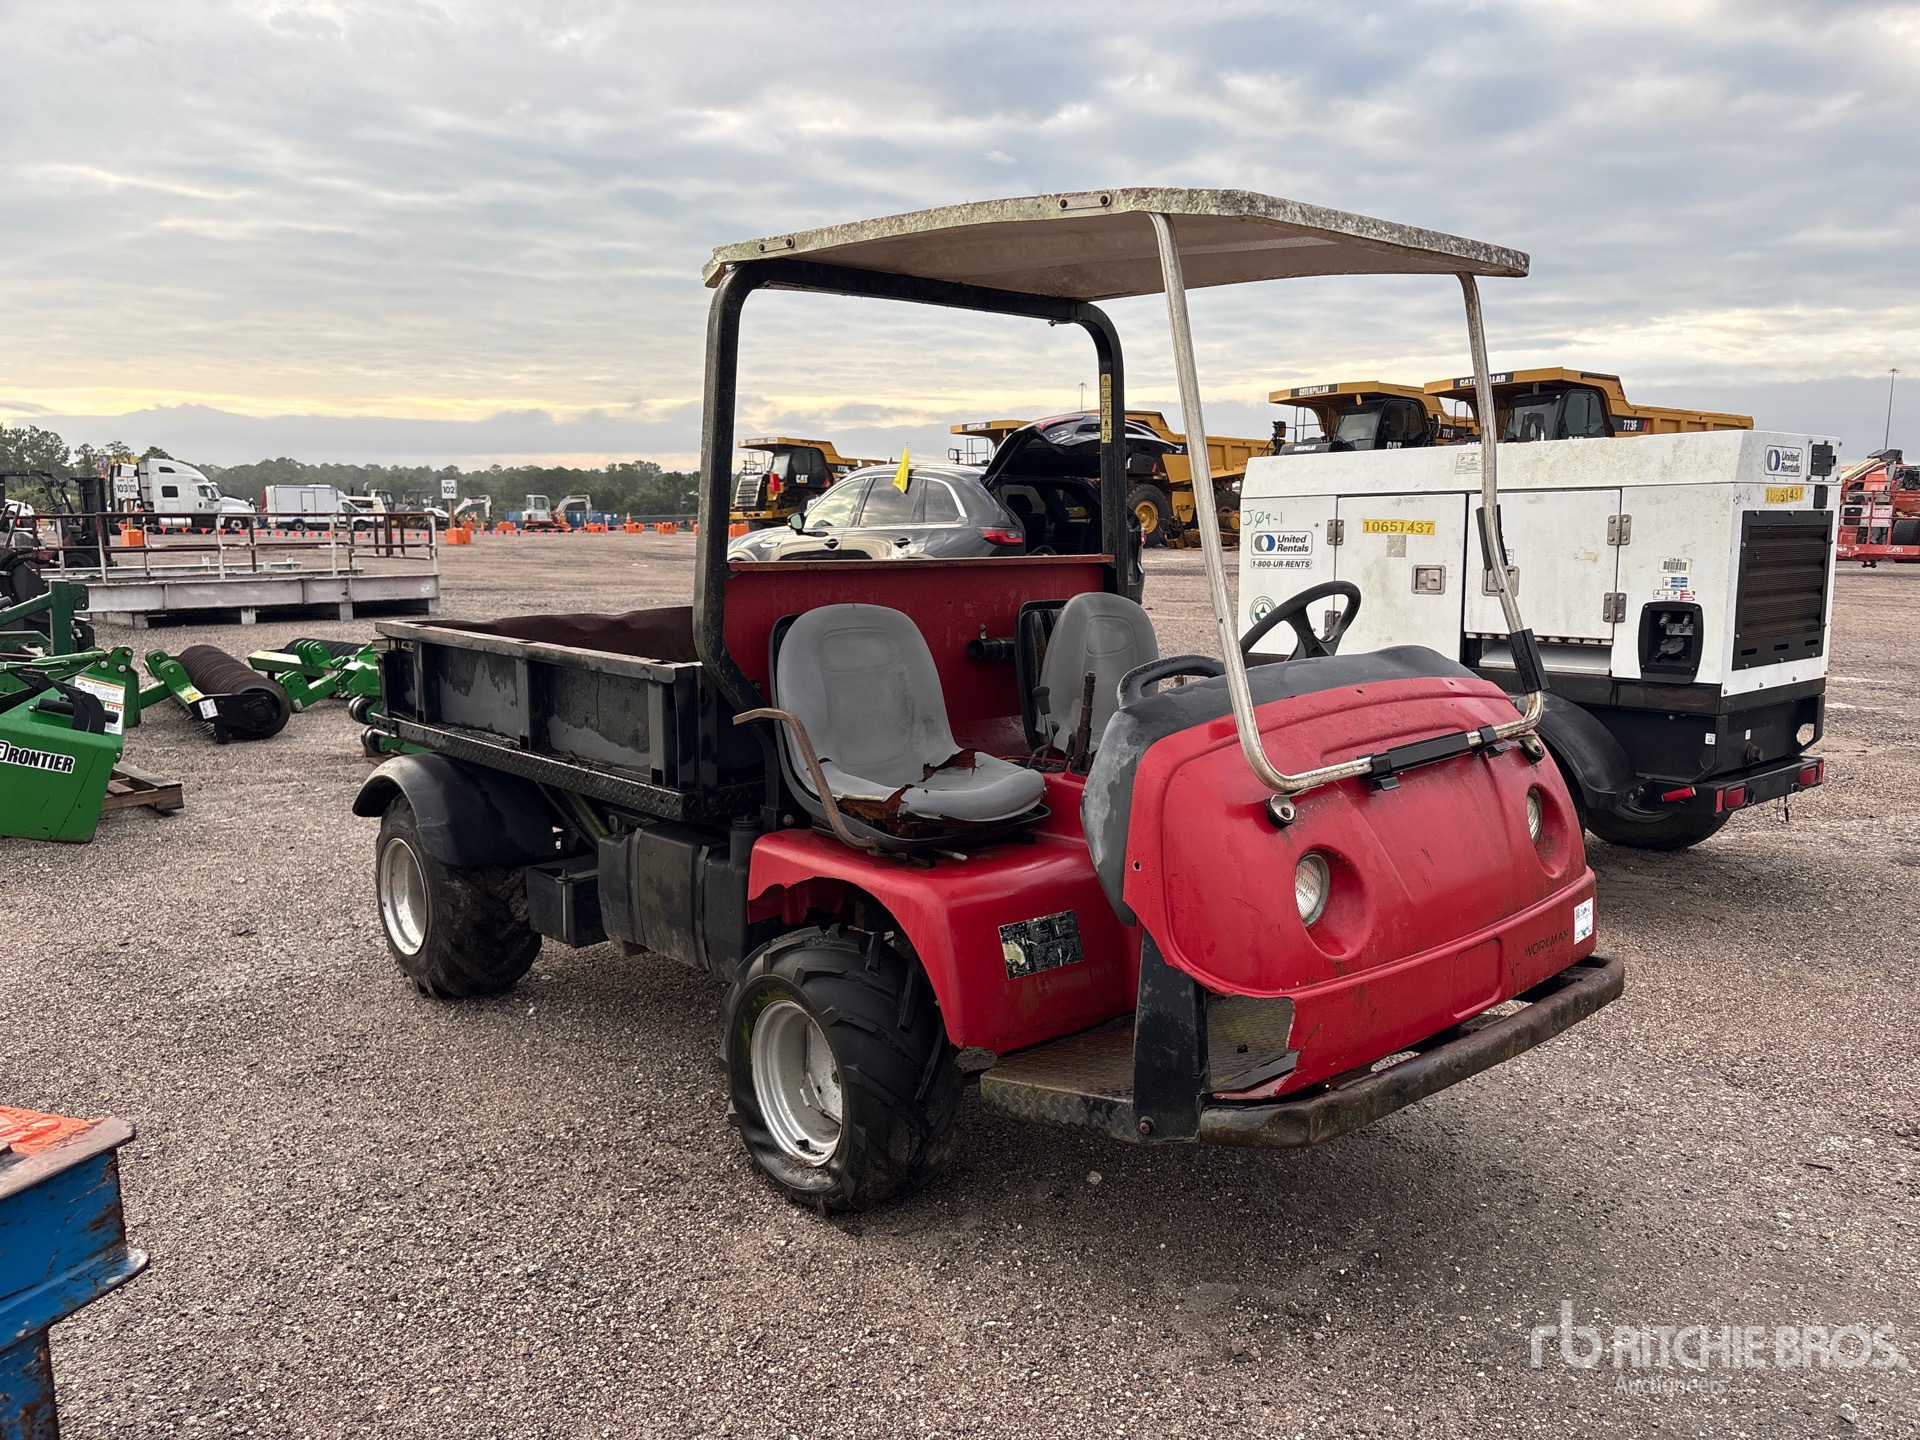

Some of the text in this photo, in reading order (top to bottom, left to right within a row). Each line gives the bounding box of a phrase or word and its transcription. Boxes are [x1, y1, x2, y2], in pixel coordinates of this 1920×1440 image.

[1623, 420, 1638, 431] 773F
[1781, 451, 1800, 462] United
[1781, 462, 1800, 473] Rentals
[796, 475, 808, 483] CAT
[116, 485, 128, 493] 103
[443, 486, 455, 494] 102
[1364, 521, 1434, 534] 10651437
[1277, 534, 1307, 543] United
[1277, 544, 1309, 552] Rentals
[1252, 560, 1310, 568] 1-800-UR-RENTS
[1524, 928, 1569, 956] WORKMAN
